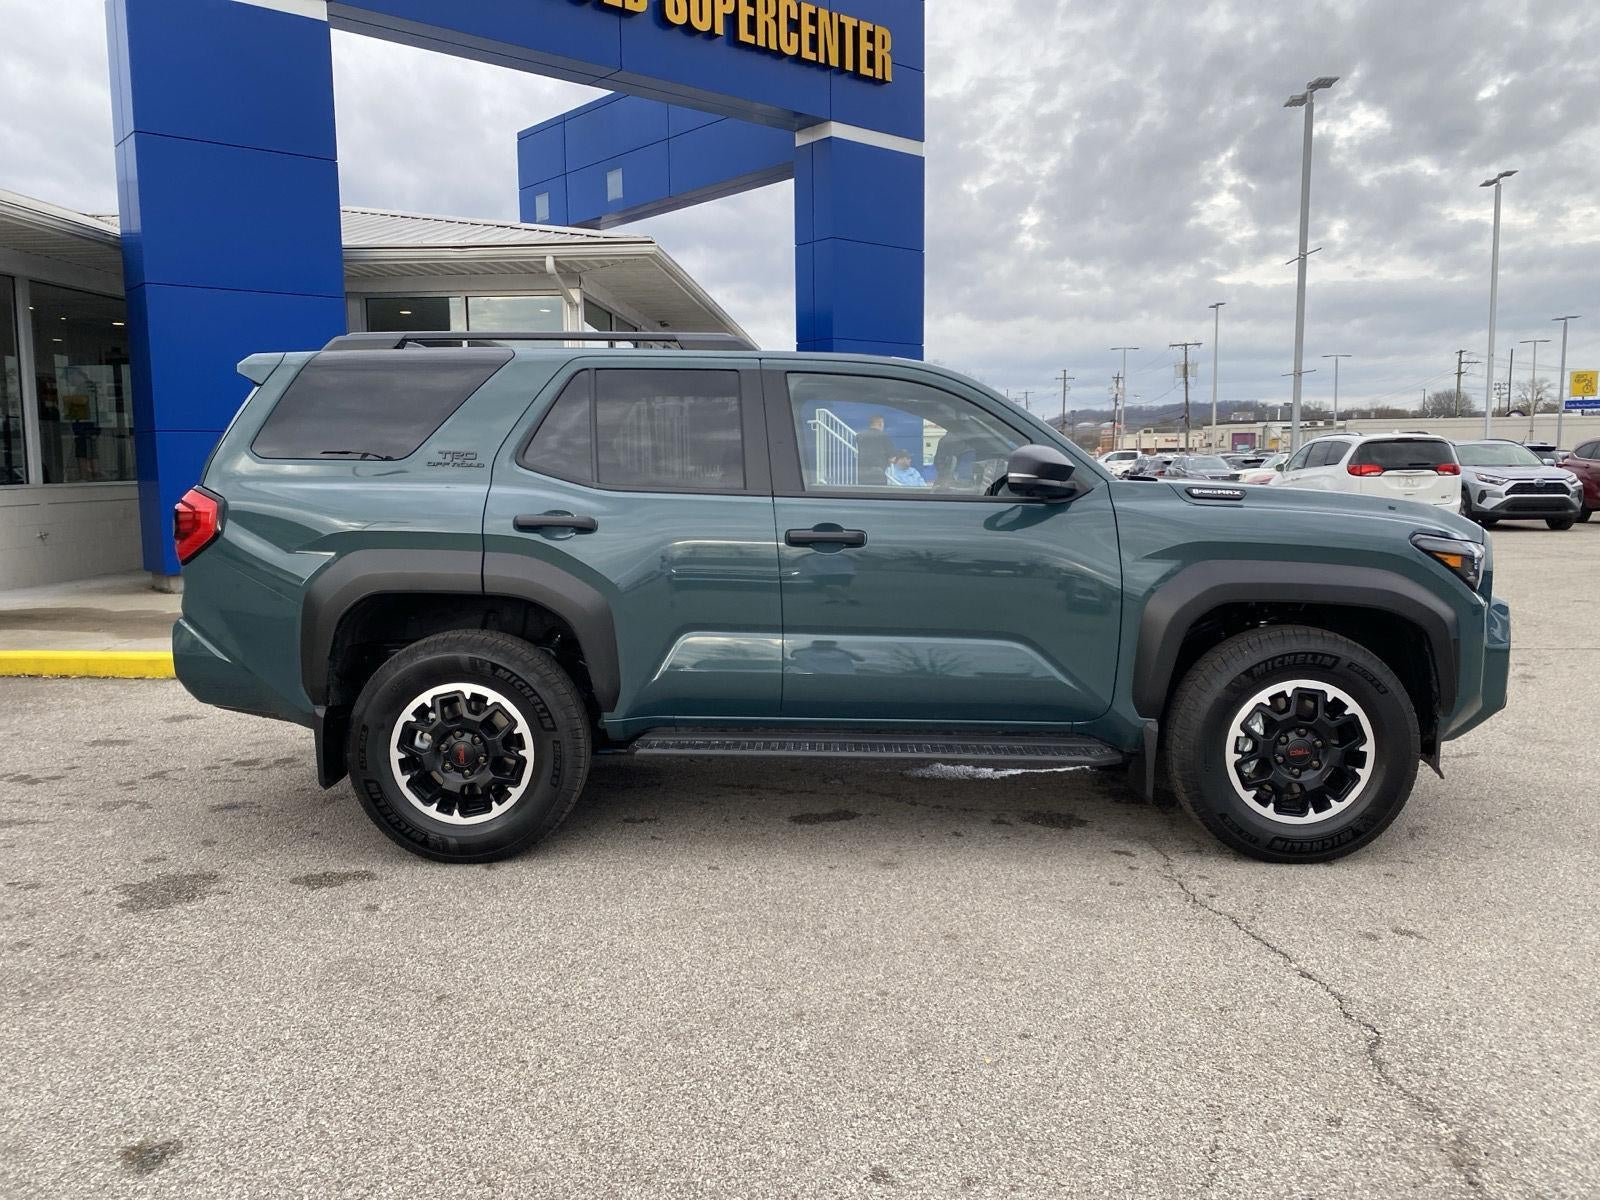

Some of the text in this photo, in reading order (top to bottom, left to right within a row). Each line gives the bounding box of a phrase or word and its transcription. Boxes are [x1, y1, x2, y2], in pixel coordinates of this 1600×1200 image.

[438, 451, 478, 462] TRD
[1253, 653, 1335, 676] MICHELIN
[493, 668, 554, 731] MICHELIN
[366, 780, 424, 844] MICHELIN
